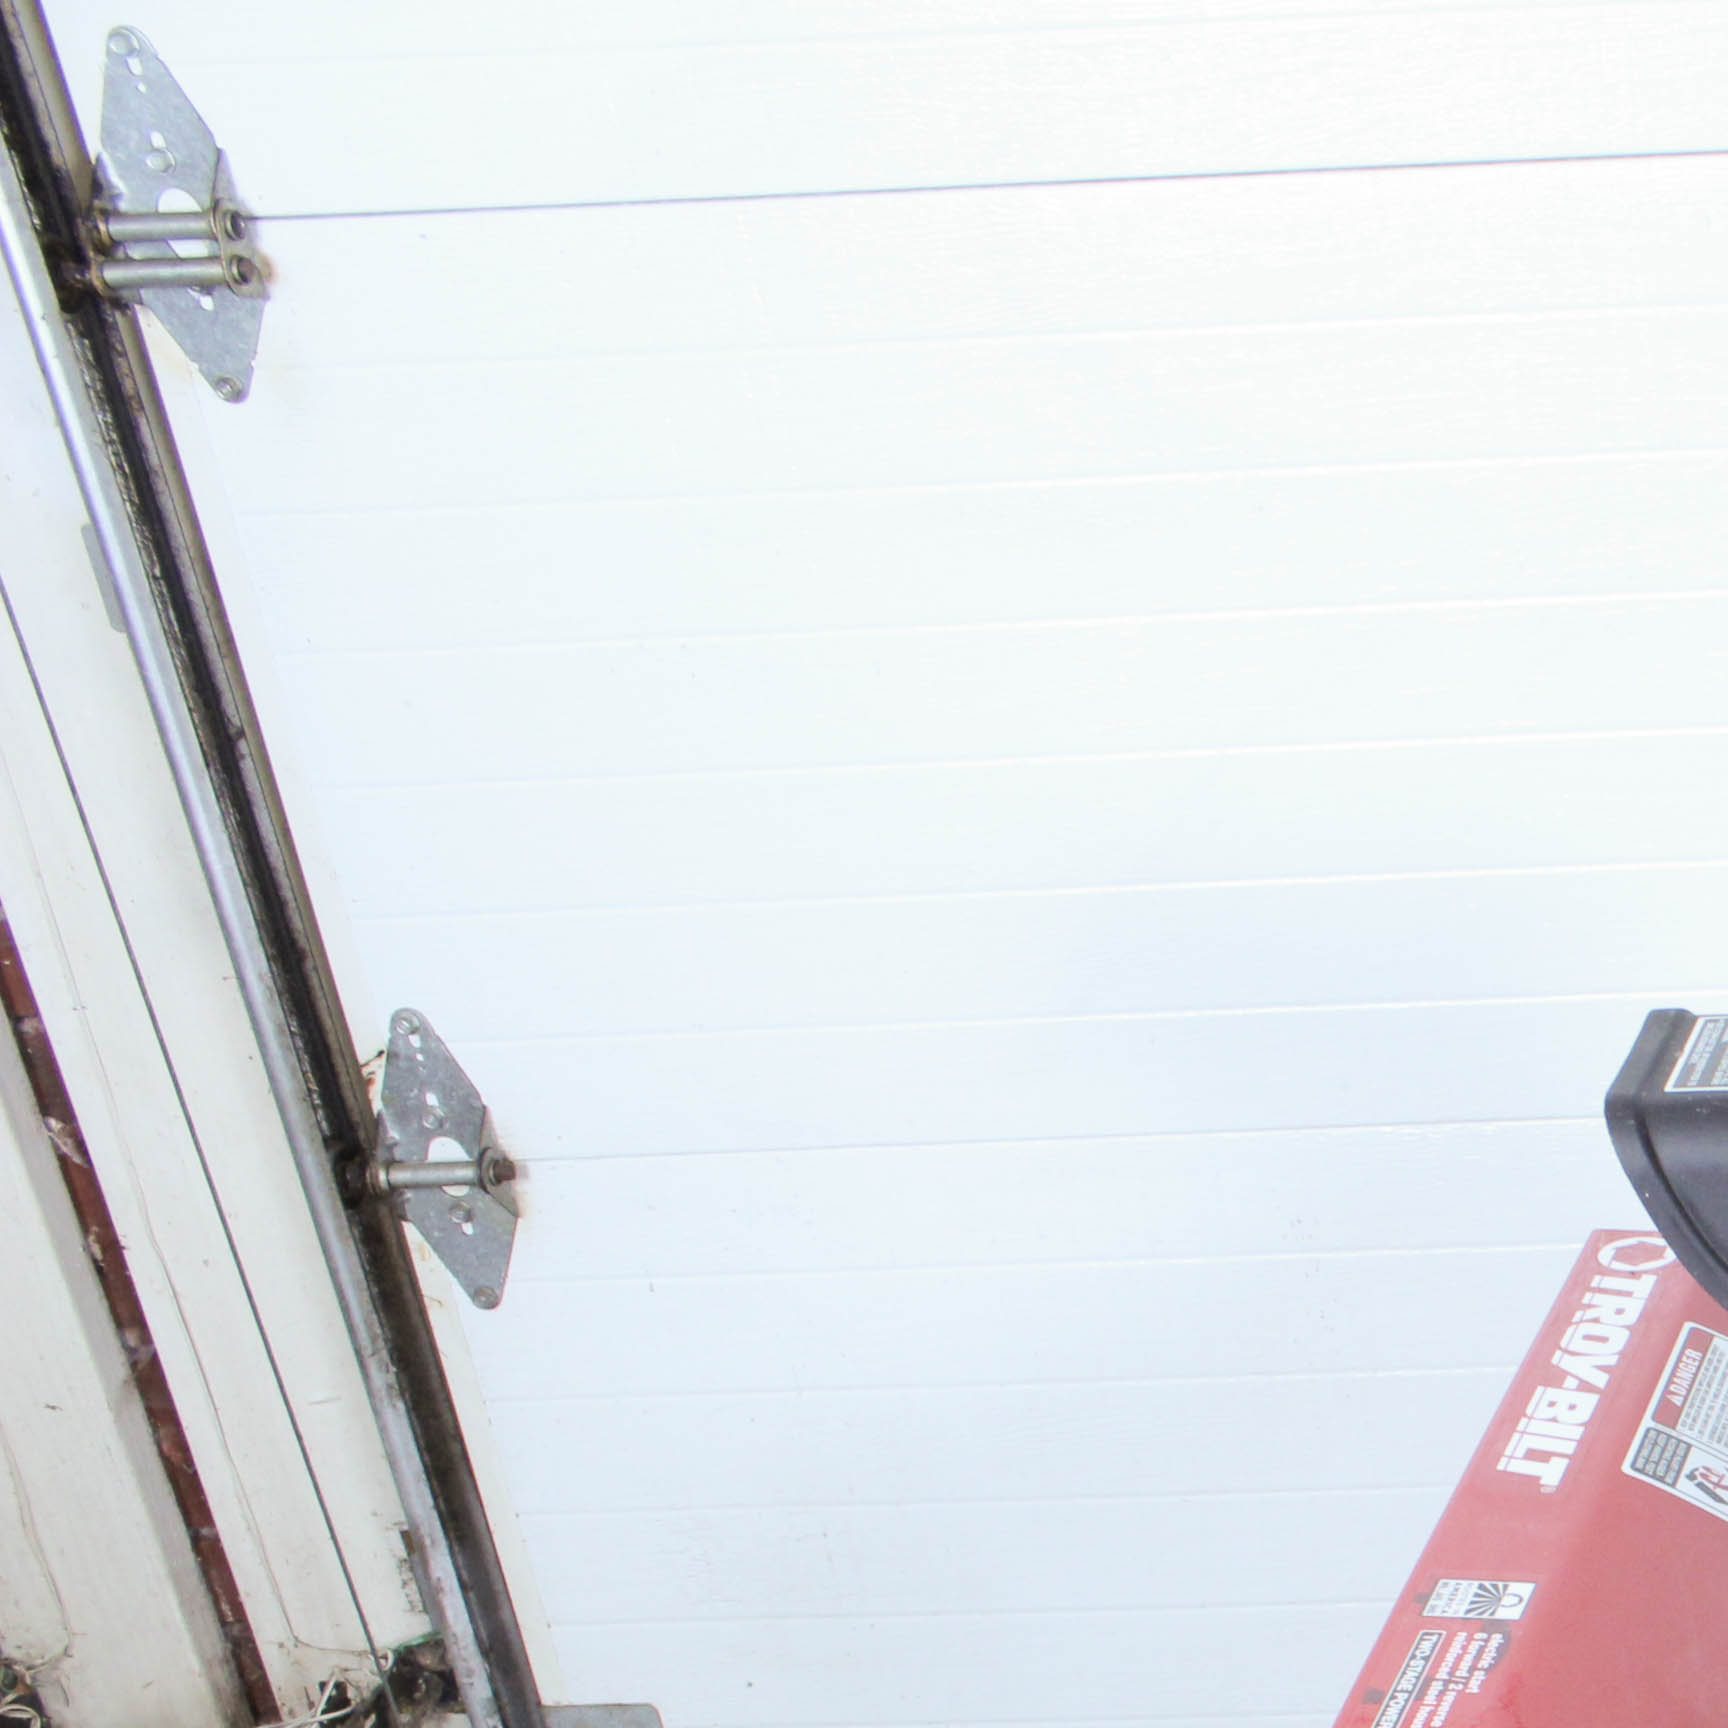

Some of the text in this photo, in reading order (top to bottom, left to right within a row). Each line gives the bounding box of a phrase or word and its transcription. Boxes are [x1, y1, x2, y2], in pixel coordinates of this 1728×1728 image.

[1496, 1273, 1658, 1486] TROY-BILT
[1673, 1348, 1704, 1399] DANGER
[1396, 1634, 1439, 1692] TWO-STAGE
[1436, 1632, 1467, 1680] reinforced
[1456, 1641, 1486, 1678] forward
[1465, 1632, 1505, 1694] electric start
[1423, 1680, 1443, 1705] steel
[1430, 1691, 1457, 1728] reverse
[1448, 1683, 1464, 1691] 2
